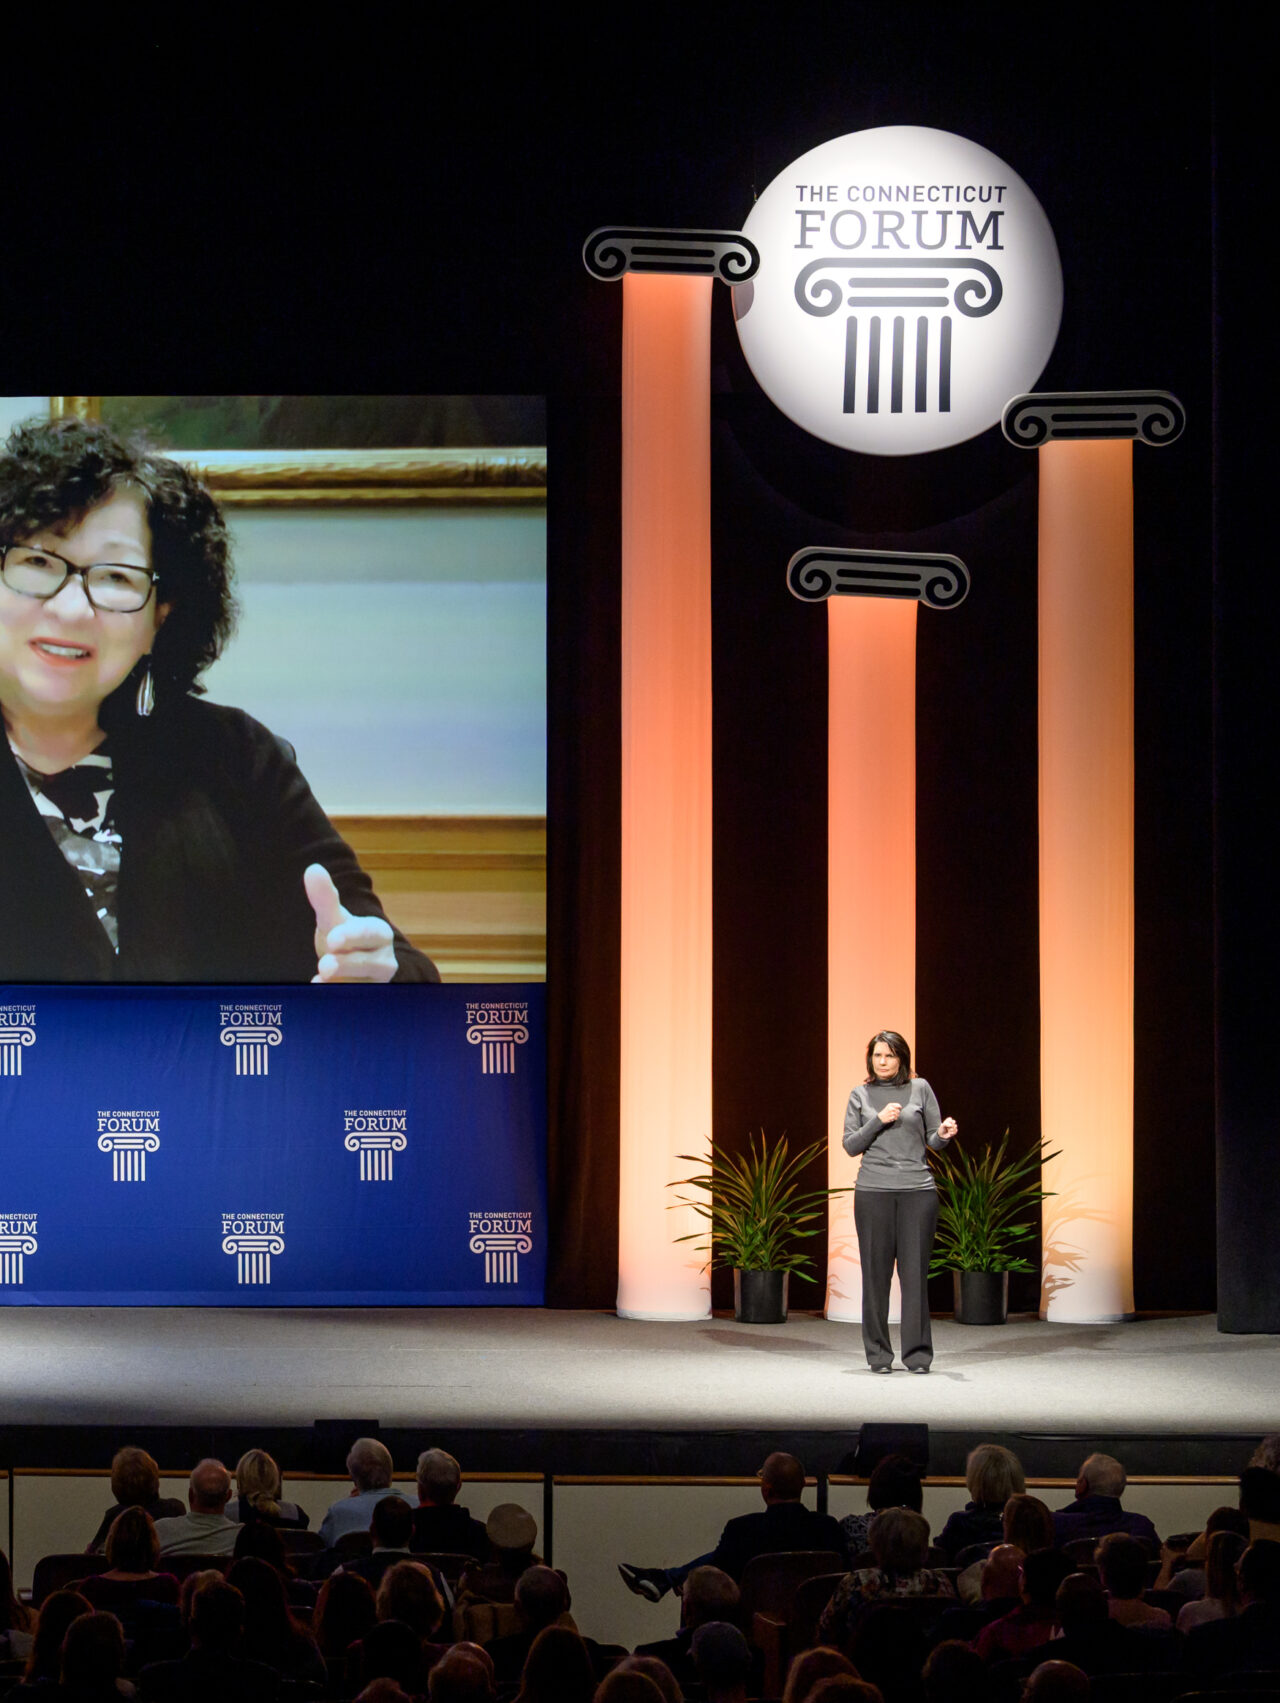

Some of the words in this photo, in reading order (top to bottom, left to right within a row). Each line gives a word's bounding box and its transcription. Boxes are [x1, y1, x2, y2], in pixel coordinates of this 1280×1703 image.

[795, 184, 839, 203] THE
[847, 184, 1007, 204] CONNECTICUT
[794, 209, 1005, 251] FORUM
[220, 1012, 282, 1025] FORUM
[466, 1010, 528, 1023] FORUM
[97, 1118, 159, 1131] FORUM
[344, 1118, 406, 1131] FORUM
[222, 1221, 284, 1234] FORUM
[469, 1220, 531, 1233] FORUM
